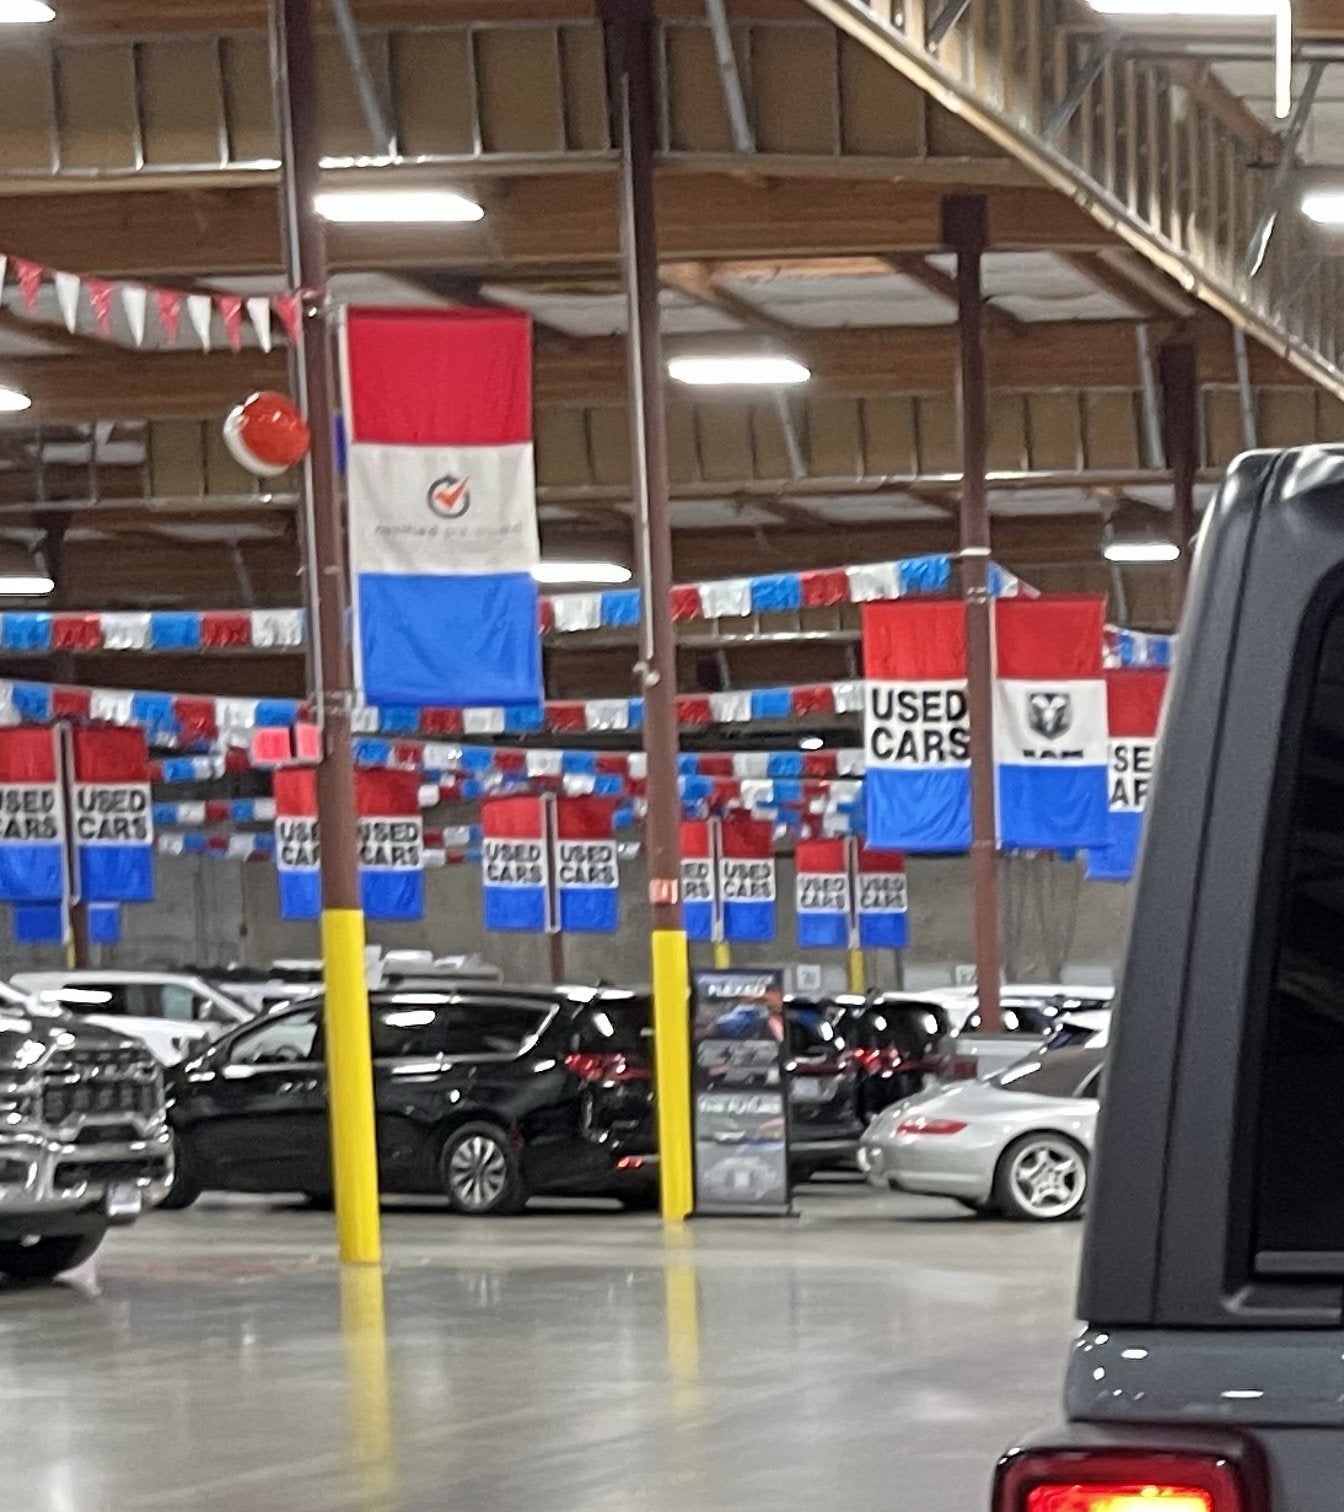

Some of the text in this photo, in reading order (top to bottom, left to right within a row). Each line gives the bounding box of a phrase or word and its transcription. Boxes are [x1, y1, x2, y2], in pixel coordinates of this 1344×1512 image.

[872, 689, 967, 723] USED
[871, 727, 969, 762] CARS
[1113, 745, 1152, 772] SE
[77, 788, 146, 813] USED
[0, 815, 58, 840] ARS
[77, 816, 148, 840] CARS
[486, 843, 541, 862] USED
[560, 844, 612, 863] USED
[487, 864, 543, 883] CARS
[559, 865, 615, 884] CARS
[723, 861, 771, 879] USED
